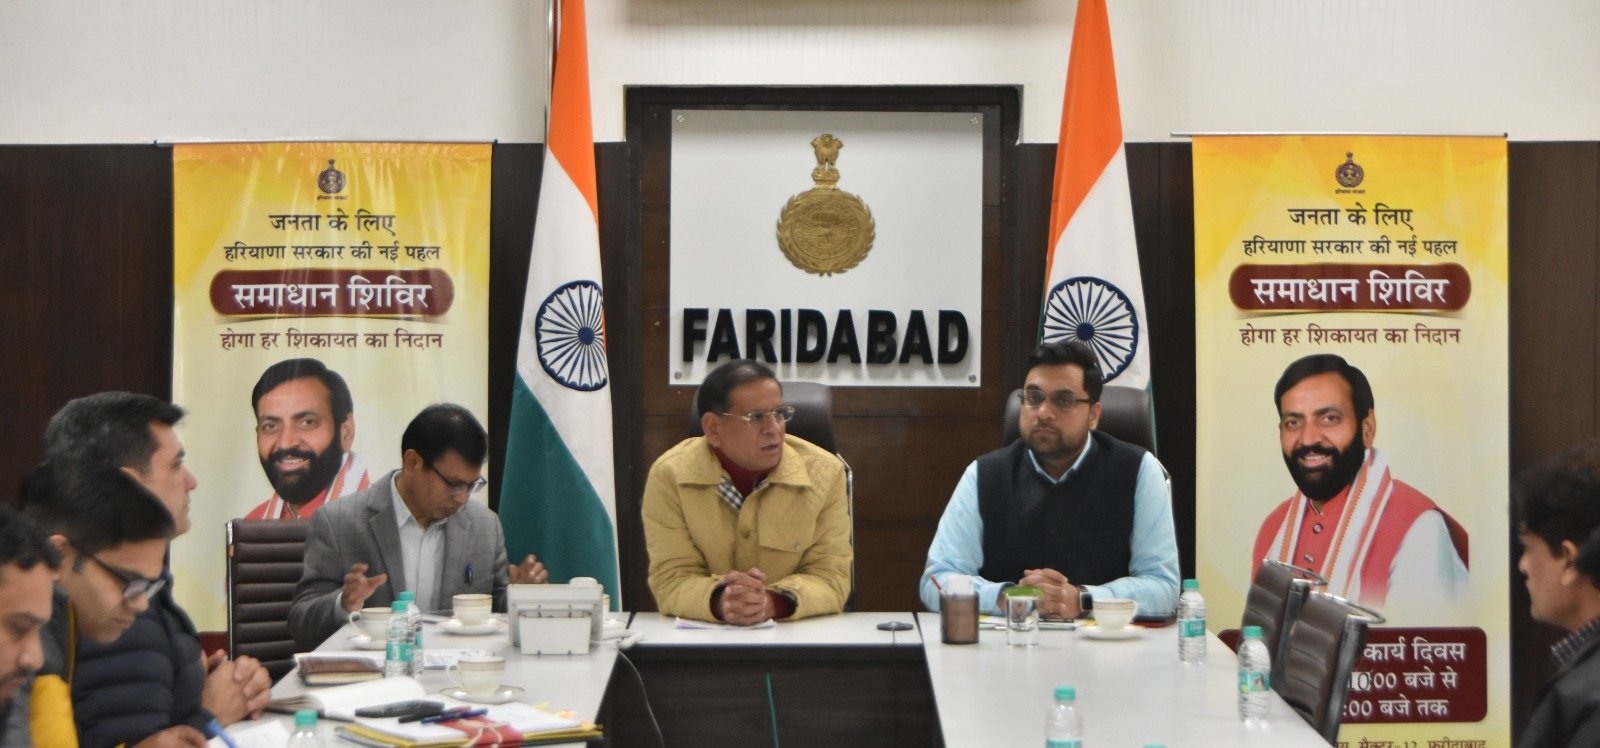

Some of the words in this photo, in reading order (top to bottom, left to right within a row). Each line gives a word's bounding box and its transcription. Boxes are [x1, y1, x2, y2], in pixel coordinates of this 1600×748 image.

[269, 214, 322, 232] जनता
[328, 207, 349, 232] के
[355, 208, 396, 236] लिए
[1287, 208, 1340, 226] जनता
[1346, 202, 1368, 226] के
[1373, 202, 1414, 231] लिए
[223, 241, 286, 262] हरियाणा
[291, 245, 345, 260] सरकार
[350, 241, 373, 260] की
[378, 240, 400, 263] नई
[404, 245, 441, 262] पहल
[1242, 235, 1306, 257] हरियाणा
[1311, 240, 1364, 255] सरकार
[1369, 235, 1392, 255] की
[1396, 235, 1418, 258] नई
[1423, 240, 1458, 256] पहल
[231, 283, 340, 309] समाधान
[347, 274, 432, 310] शिविर
[1250, 278, 1360, 305] समाधान
[1366, 269, 1451, 306] शिविर
[220, 327, 255, 350] होगा
[260, 332, 281, 350] हर
[286, 327, 358, 350] शिकायत
[364, 332, 389, 349] का
[394, 327, 443, 350] निदान
[682, 307, 970, 365] FARIDABAD
[1239, 323, 1276, 346] होगा
[1281, 328, 1301, 345] हर
[1306, 323, 1377, 346] शिकायत
[1383, 328, 1409, 344] का
[1413, 323, 1461, 346] निदान
[1363, 637, 1407, 661] कार्य
[1412, 637, 1466, 663] दिवस
[1403, 666, 1435, 688] बजे
[1440, 666, 1458, 688] से
[1343, 700, 1372, 716] :00
[1378, 693, 1411, 716] बजे
[1415, 699, 1449, 716] तक
